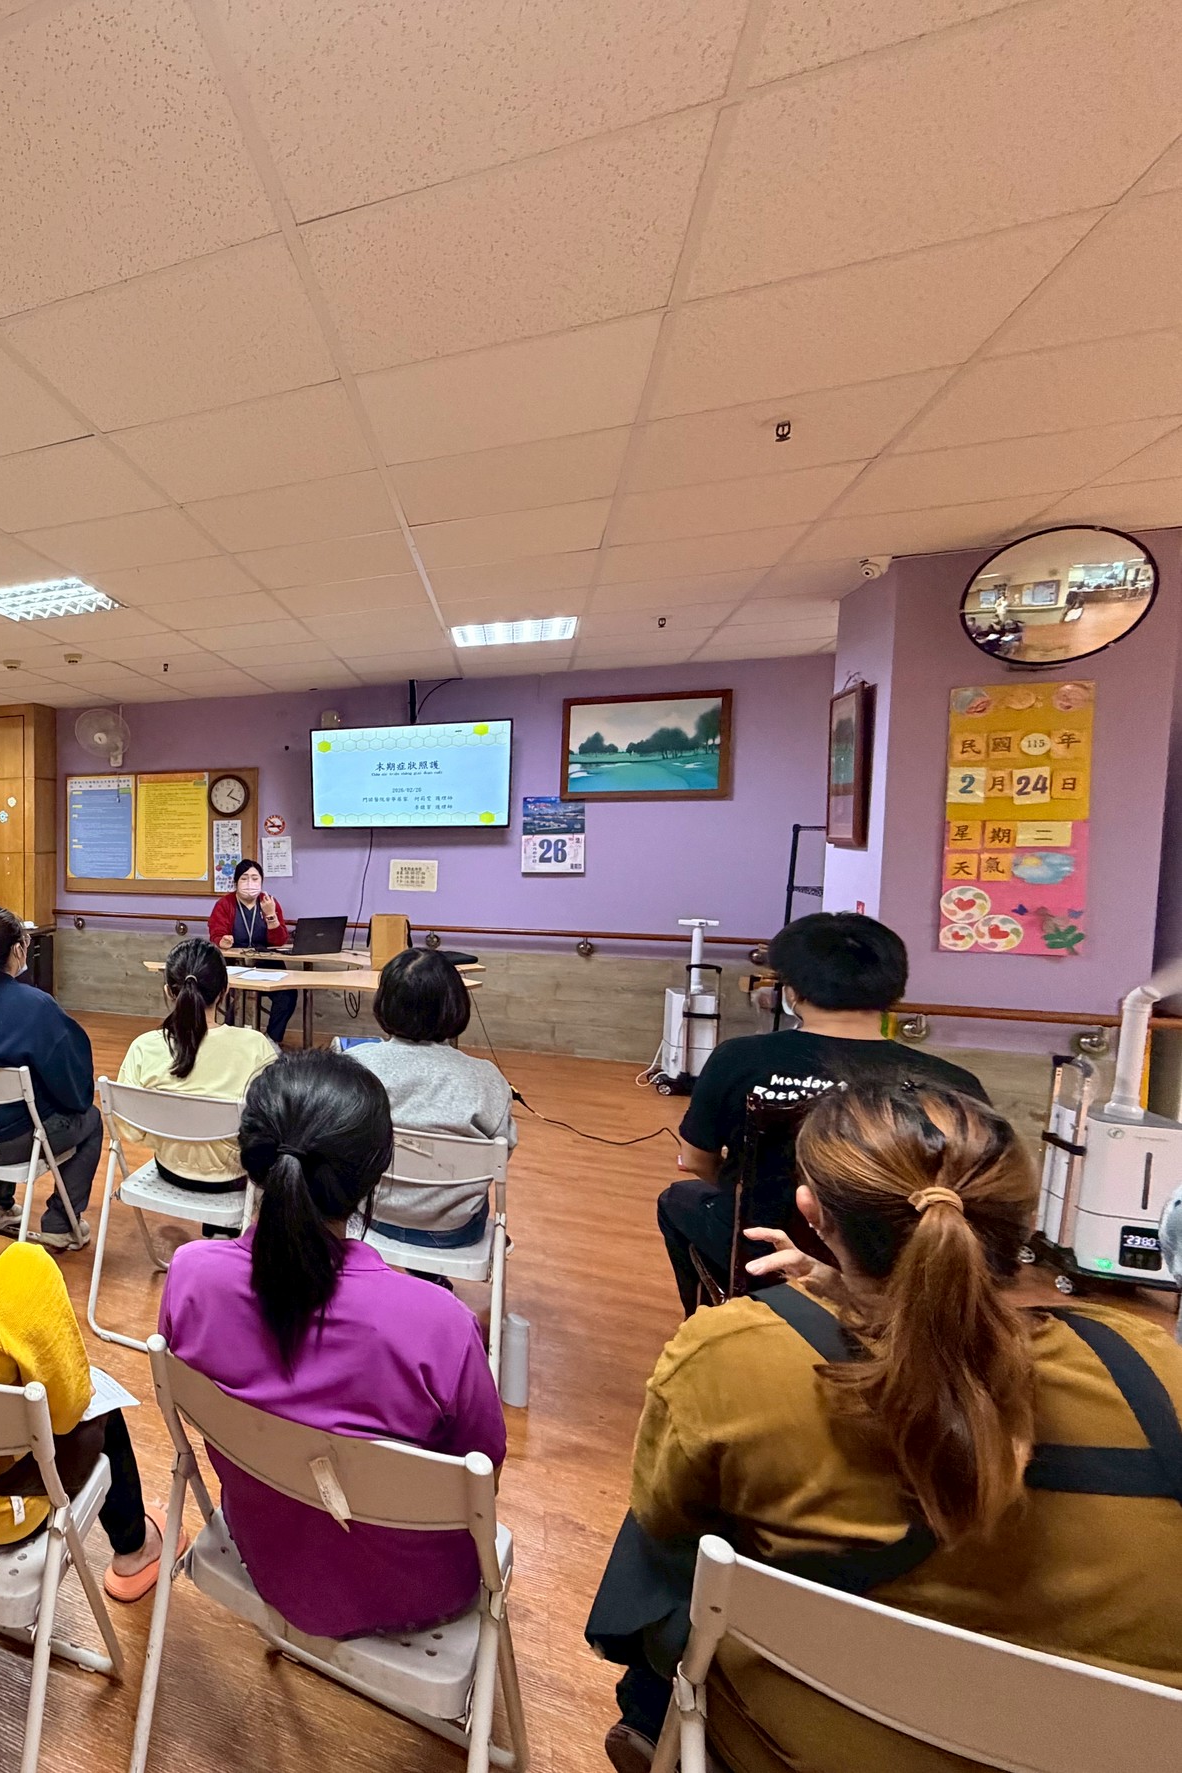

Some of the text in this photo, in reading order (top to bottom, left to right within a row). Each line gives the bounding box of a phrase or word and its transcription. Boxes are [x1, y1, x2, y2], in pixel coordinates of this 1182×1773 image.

[539, 839, 567, 863] 26
[952, 856, 1005, 876] 天氣
[770, 1074, 835, 1090] Monday
